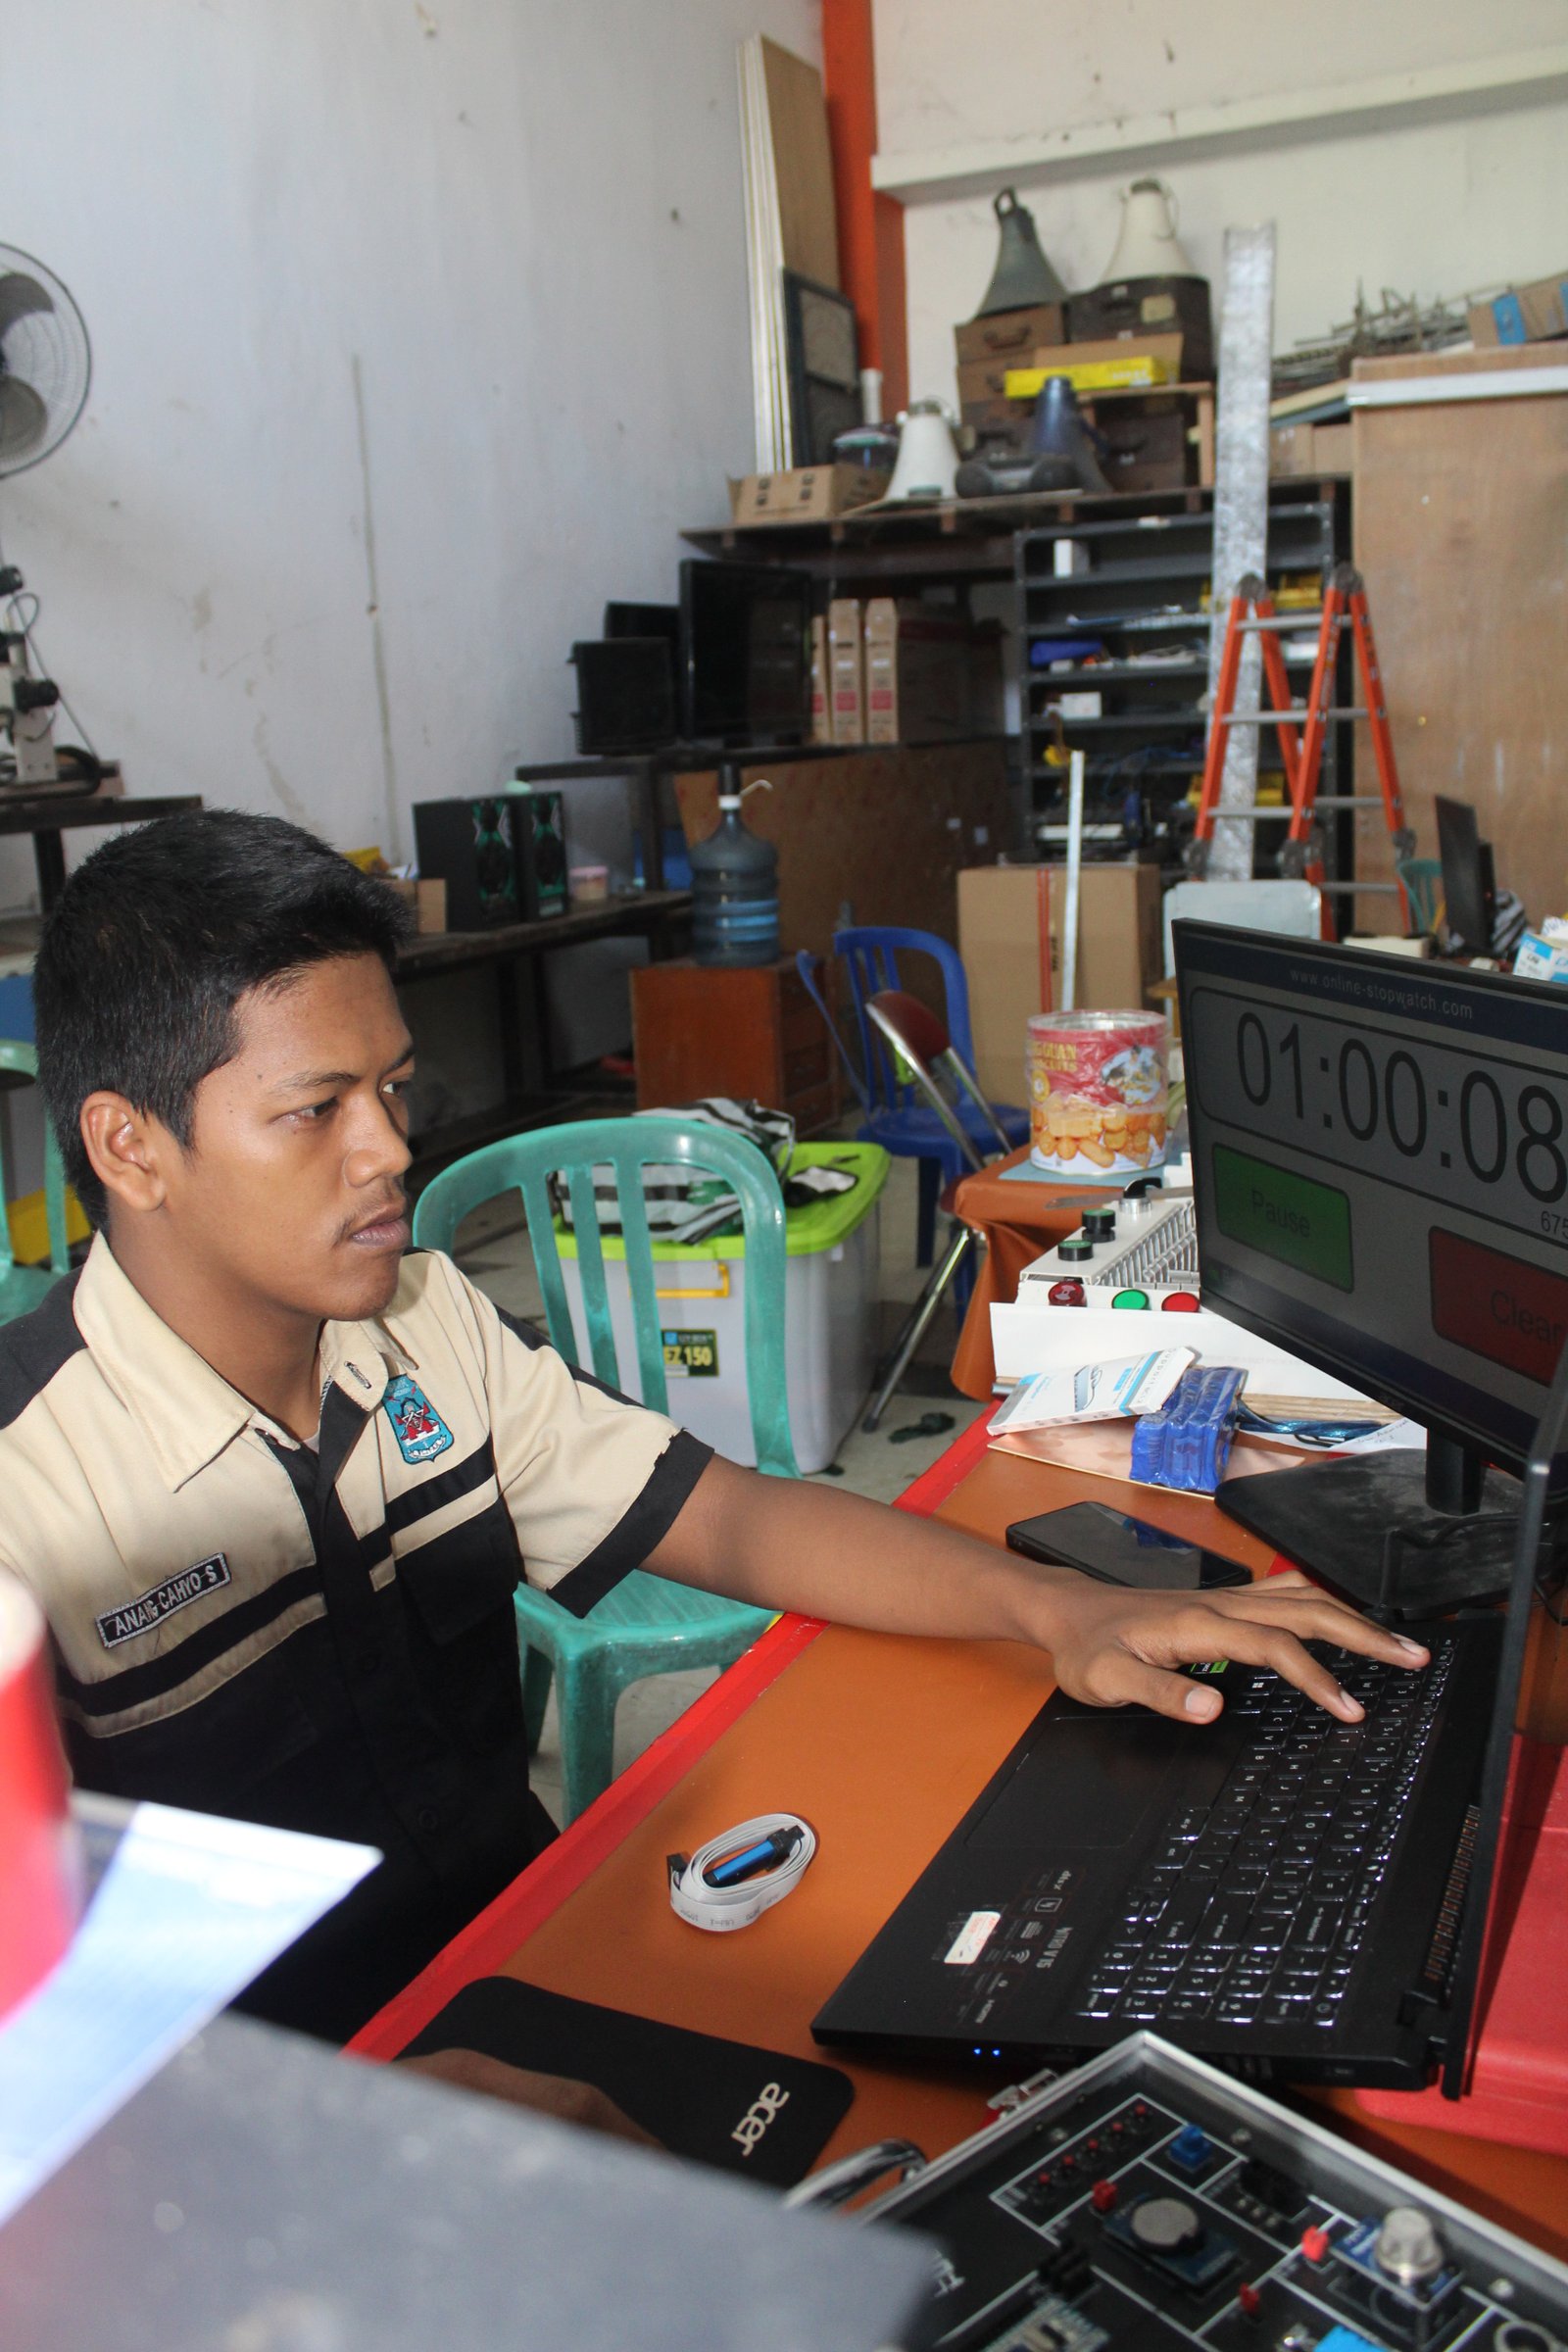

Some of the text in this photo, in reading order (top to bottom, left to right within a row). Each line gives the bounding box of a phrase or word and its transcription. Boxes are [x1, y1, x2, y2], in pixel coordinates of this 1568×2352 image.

[1290, 966, 1474, 1020] www.online-stopwatch.com
[1237, 1012, 1568, 1203] 01:00:08
[1250, 1189, 1311, 1239] Pause
[1491, 1288, 1566, 1347] Clear
[158, 1572, 201, 1610] CAHYO
[204, 1565, 217, 1584] S
[731, 2082, 790, 2157] acer
